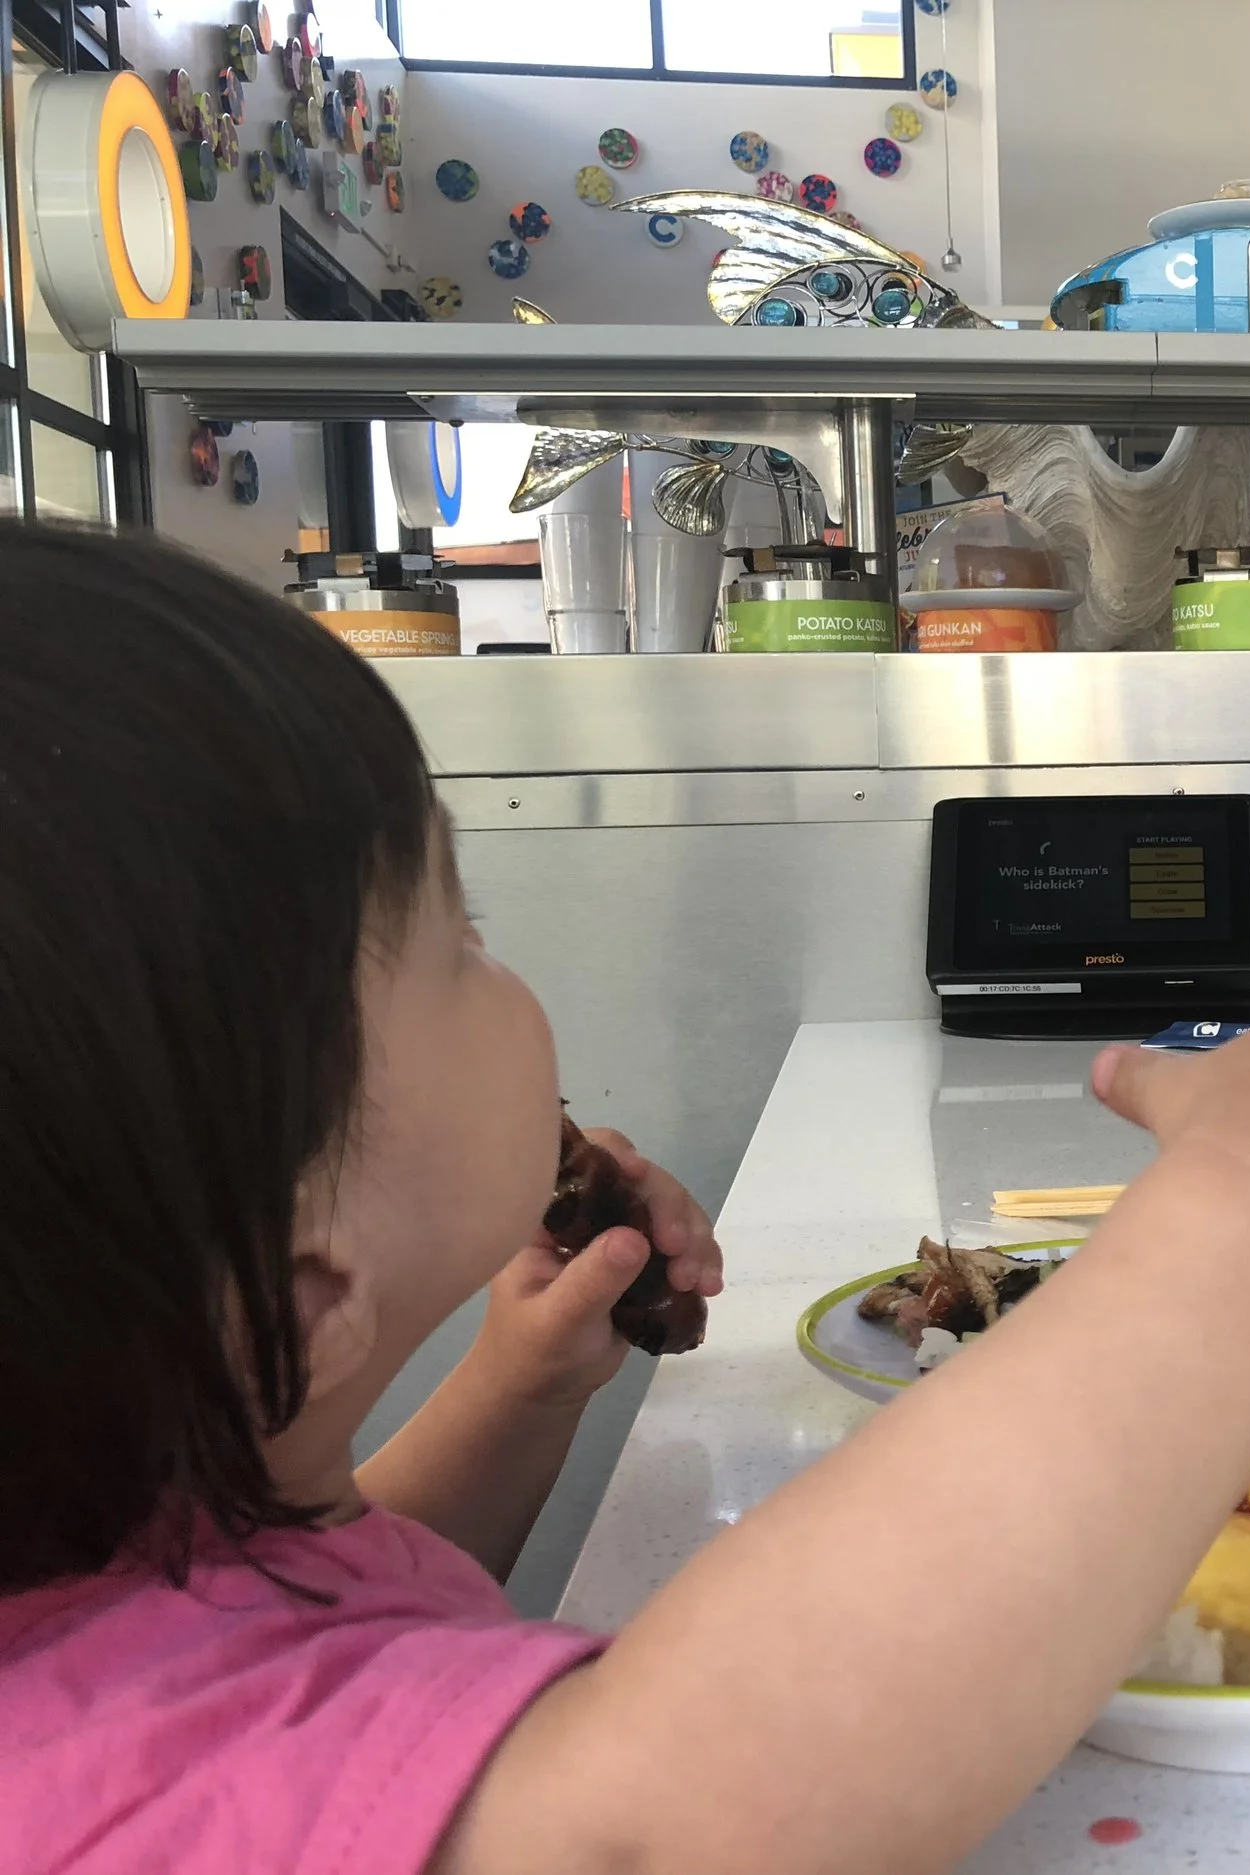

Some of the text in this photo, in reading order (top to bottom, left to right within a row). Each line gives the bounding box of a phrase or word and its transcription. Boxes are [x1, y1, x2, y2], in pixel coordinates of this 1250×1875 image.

[1165, 252, 1198, 289] C
[904, 514, 928, 527] JOIN
[1180, 603, 1214, 619] KATSU
[797, 616, 887, 632] POTATO KATSU
[927, 622, 982, 637] GUNKAN
[340, 629, 456, 646] VEGETABLE SPRING
[787, 633, 842, 642] panko-crusted
[998, 865, 1109, 877] Who is Batman's
[1023, 879, 1084, 891] sidekick?
[1085, 952, 1125, 966] presto
